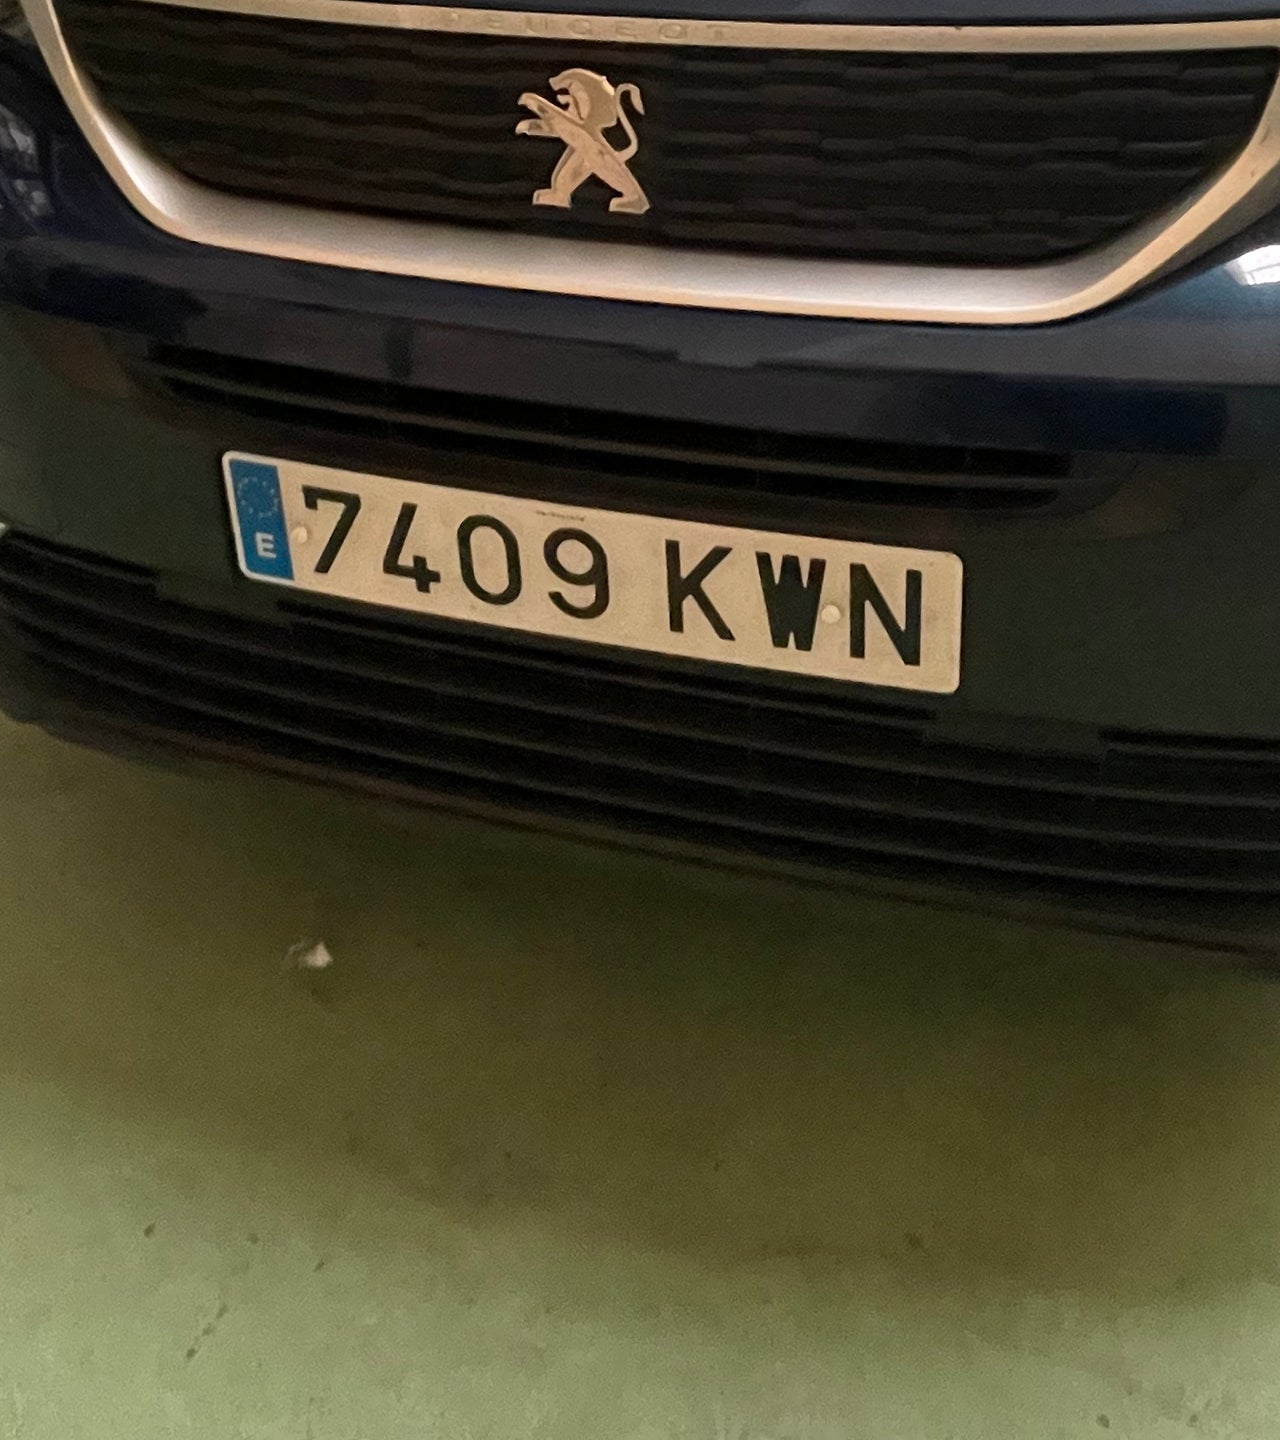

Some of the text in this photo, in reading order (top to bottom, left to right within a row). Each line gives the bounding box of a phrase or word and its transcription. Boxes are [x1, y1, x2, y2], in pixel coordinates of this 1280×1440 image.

[442, 11, 733, 41] PEUGEOT
[254, 531, 277, 558] E
[301, 484, 923, 667] 7409 KWN
